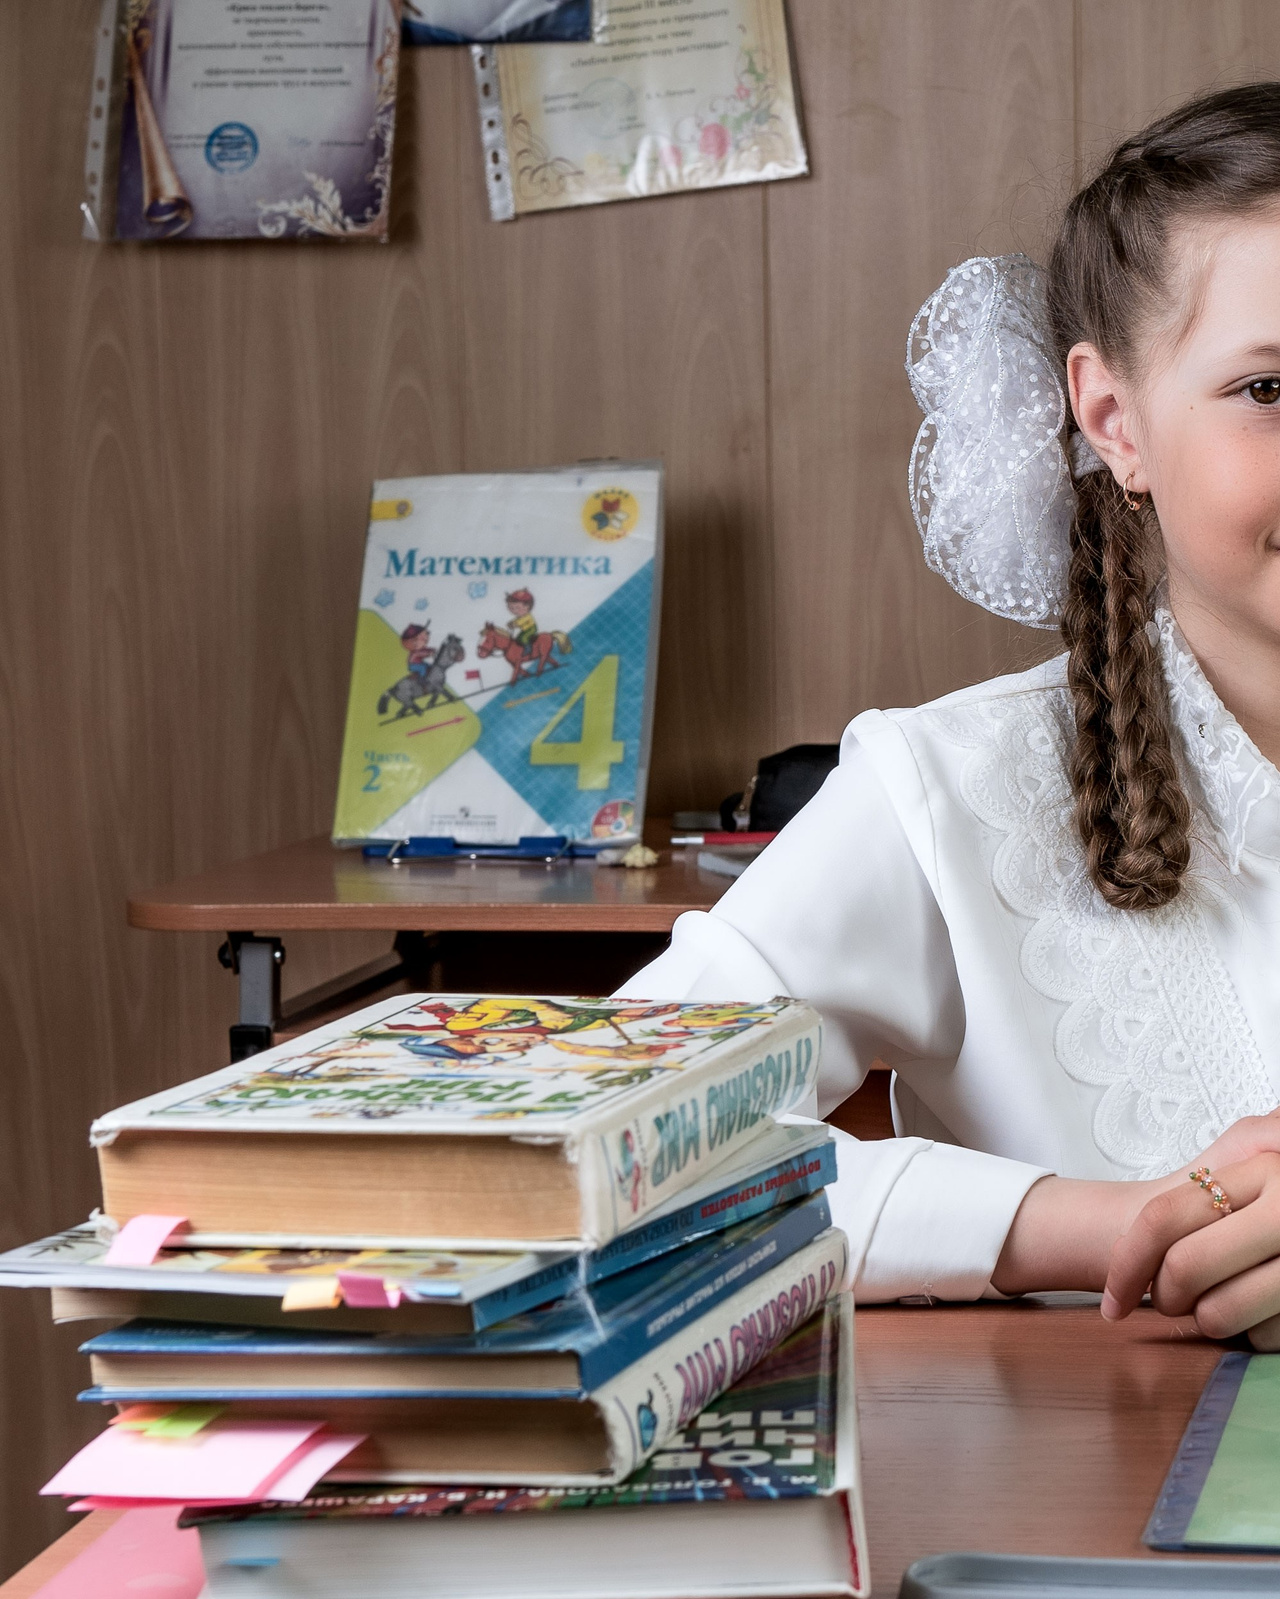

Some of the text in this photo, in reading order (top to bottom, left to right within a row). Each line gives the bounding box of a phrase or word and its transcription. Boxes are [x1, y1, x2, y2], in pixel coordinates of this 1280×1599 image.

[384, 547, 612, 577] Математика
[530, 655, 625, 791] 4
[363, 751, 411, 763] Часть
[362, 765, 381, 792] 2
[237, 1086, 531, 1103] ПОЗНАЮ
[372, 1079, 531, 1091] МИР
[706, 1050, 792, 1151] ПОЗНАЮ
[651, 1098, 701, 1187] МИР
[701, 1185, 763, 1219] РАЗРАБОТКИ
[674, 1338, 727, 1428] МИР
[658, 1429, 816, 1449] ЧИТ
[652, 1448, 815, 1470] ГОВ
